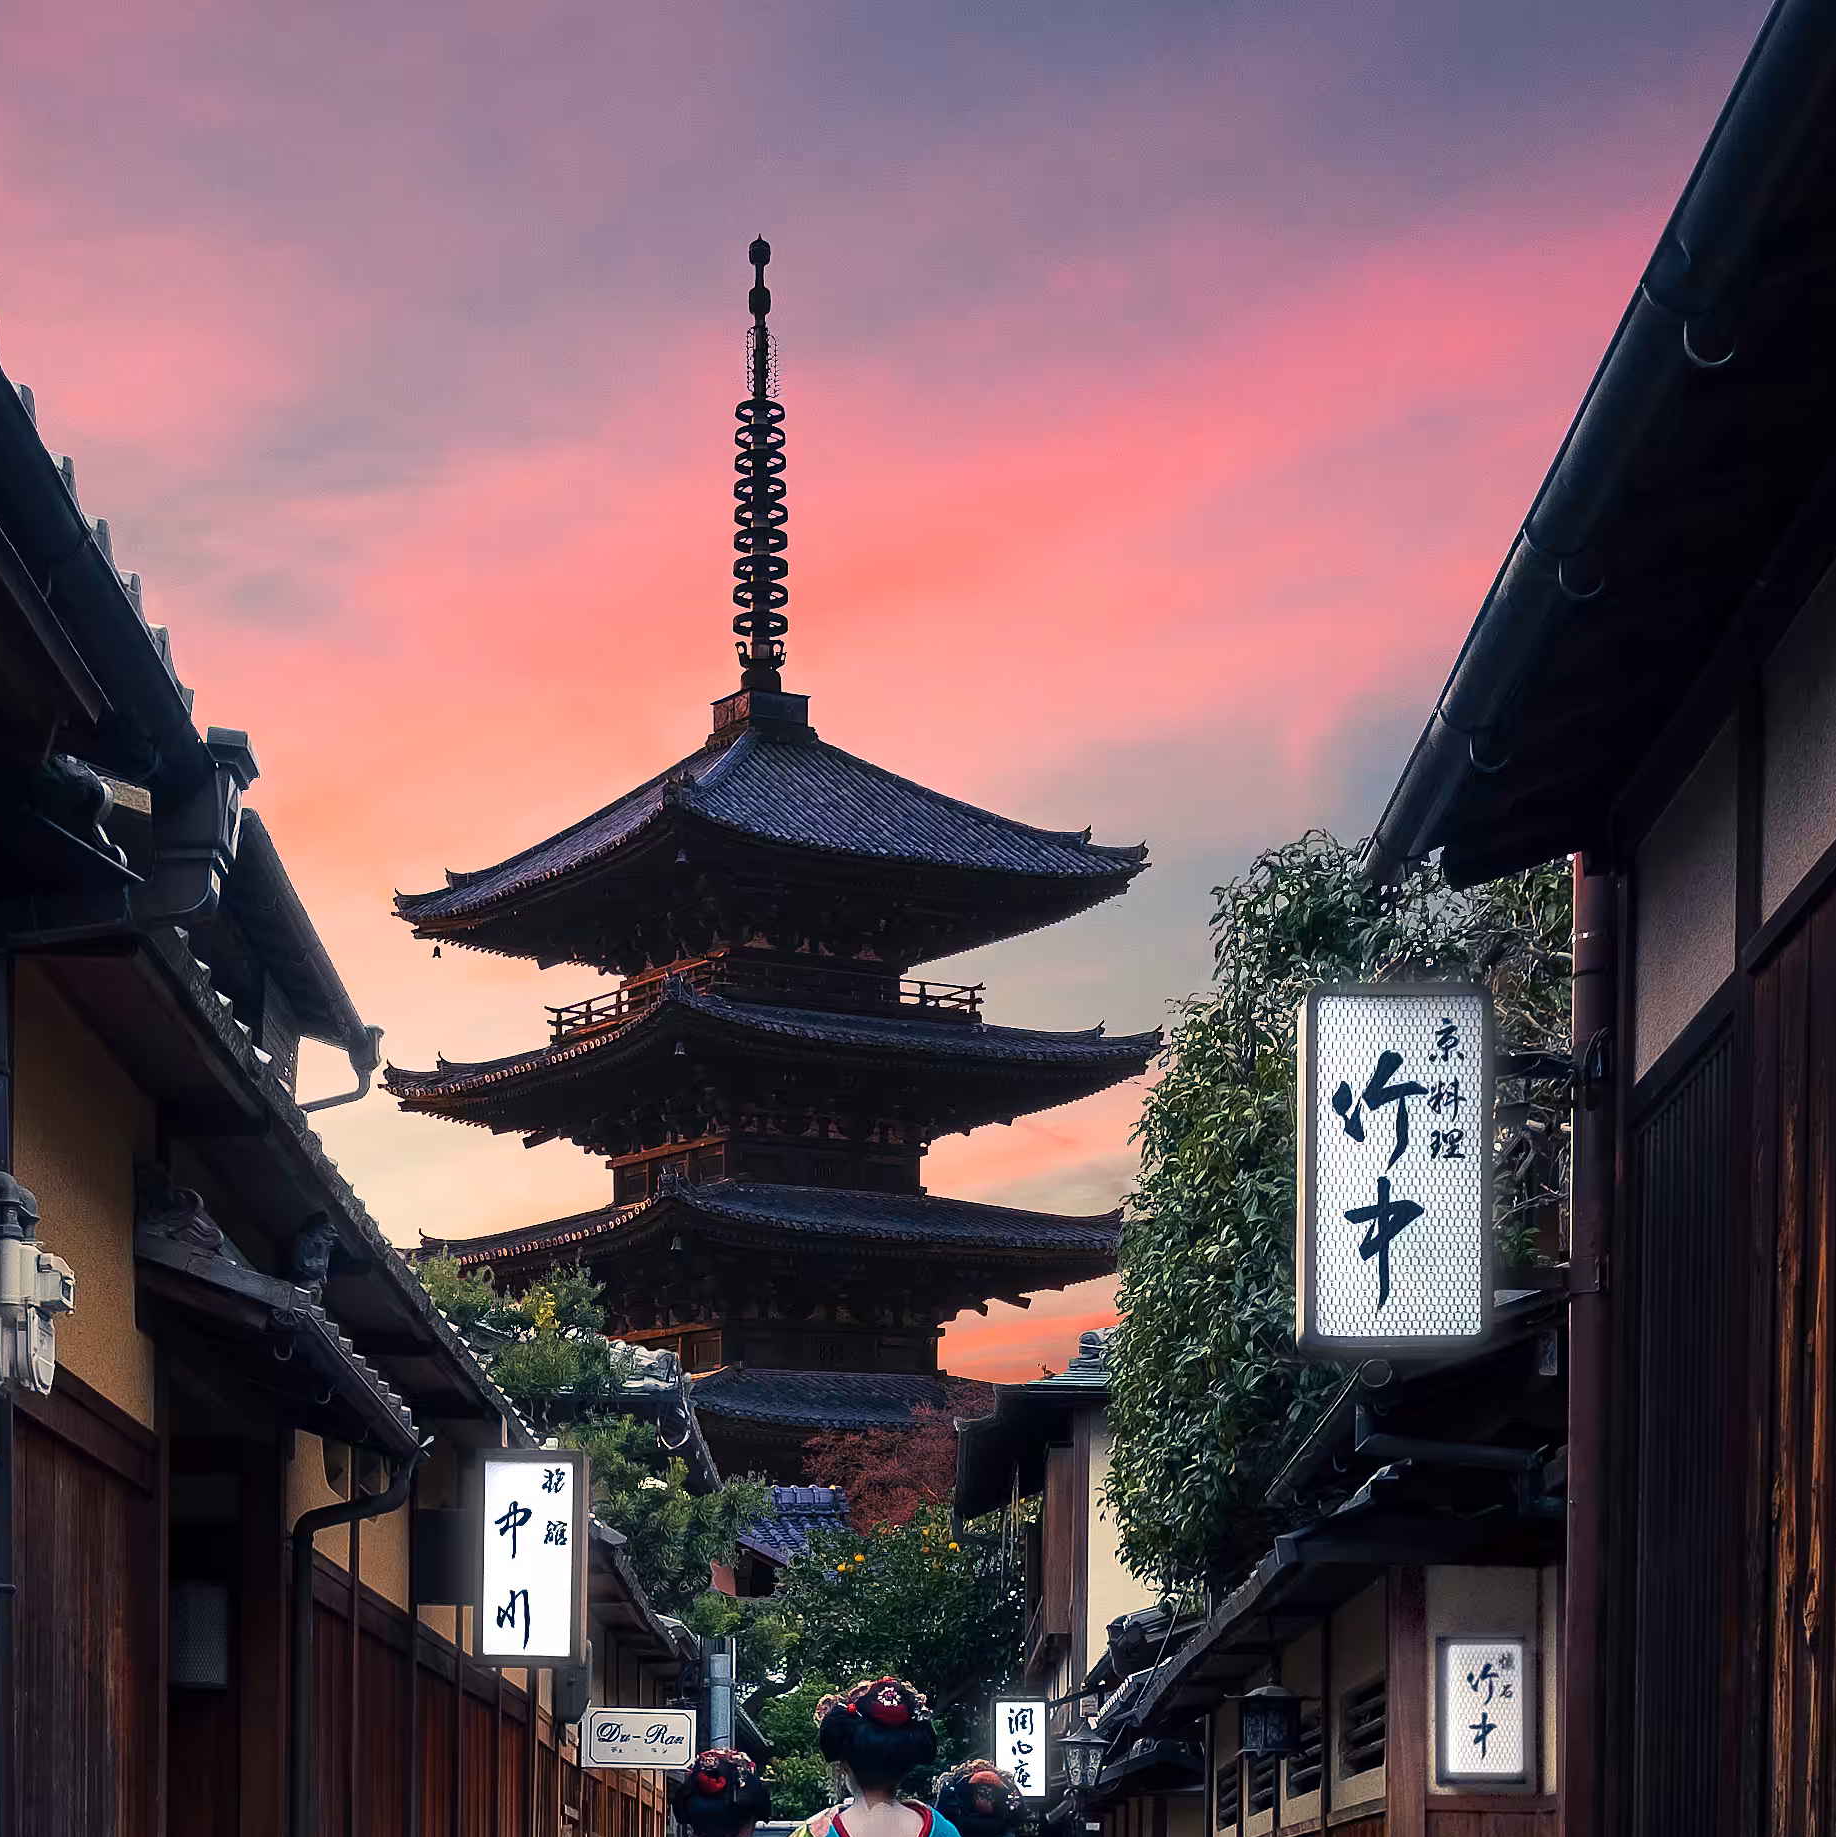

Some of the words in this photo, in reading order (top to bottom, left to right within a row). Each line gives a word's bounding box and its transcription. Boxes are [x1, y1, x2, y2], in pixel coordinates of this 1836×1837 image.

[1427, 1017, 1467, 1159] 京料理
[1332, 1050, 1428, 1312] 竹中
[494, 1501, 532, 1650] 中川
[1467, 1663, 1499, 1760] 竹中
